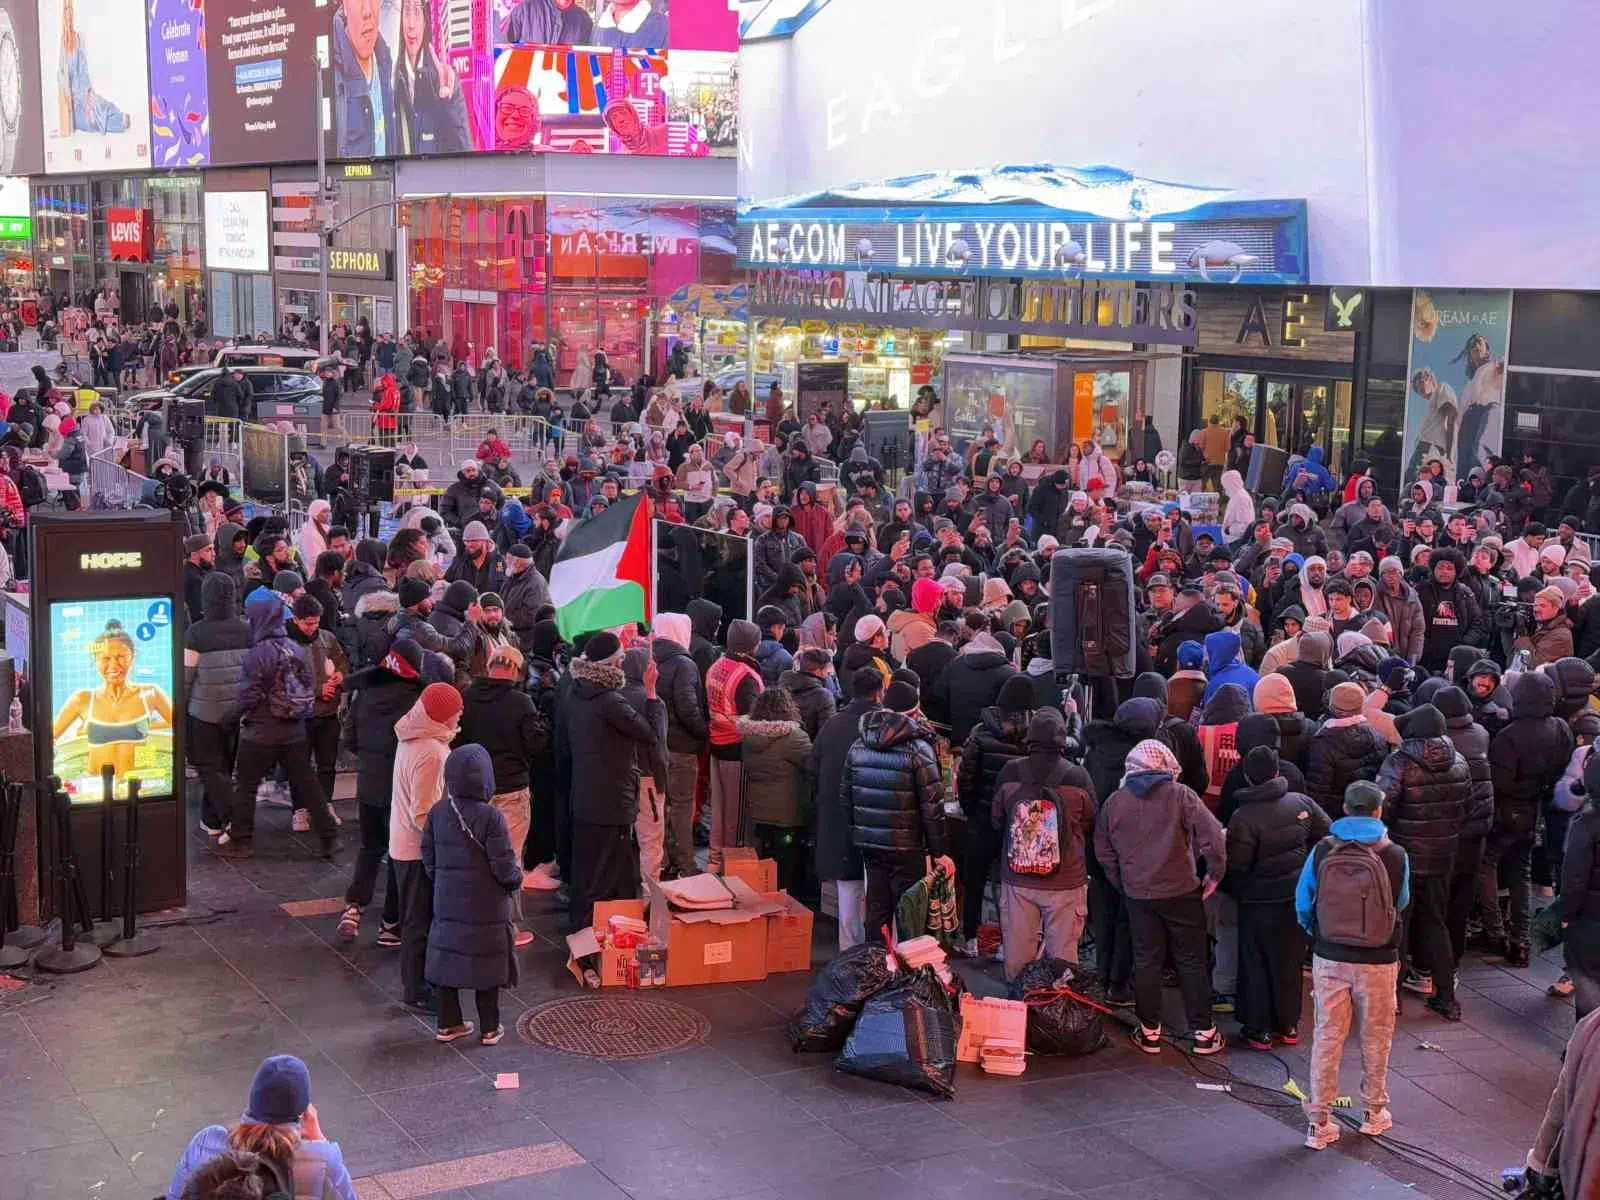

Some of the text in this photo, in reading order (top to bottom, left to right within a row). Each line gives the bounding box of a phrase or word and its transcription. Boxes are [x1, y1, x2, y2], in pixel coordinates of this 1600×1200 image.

[161, 19, 191, 40] Celebrate
[454, 55, 469, 73] NYC
[345, 165, 372, 177] SEPHORA
[897, 223, 969, 269] LIVE
[975, 222, 1074, 272] YOUR
[1085, 222, 1176, 274] LIFE
[330, 251, 380, 272] SEPHORA
[1236, 293, 1308, 347] AE
[80, 552, 142, 569] HOPE
